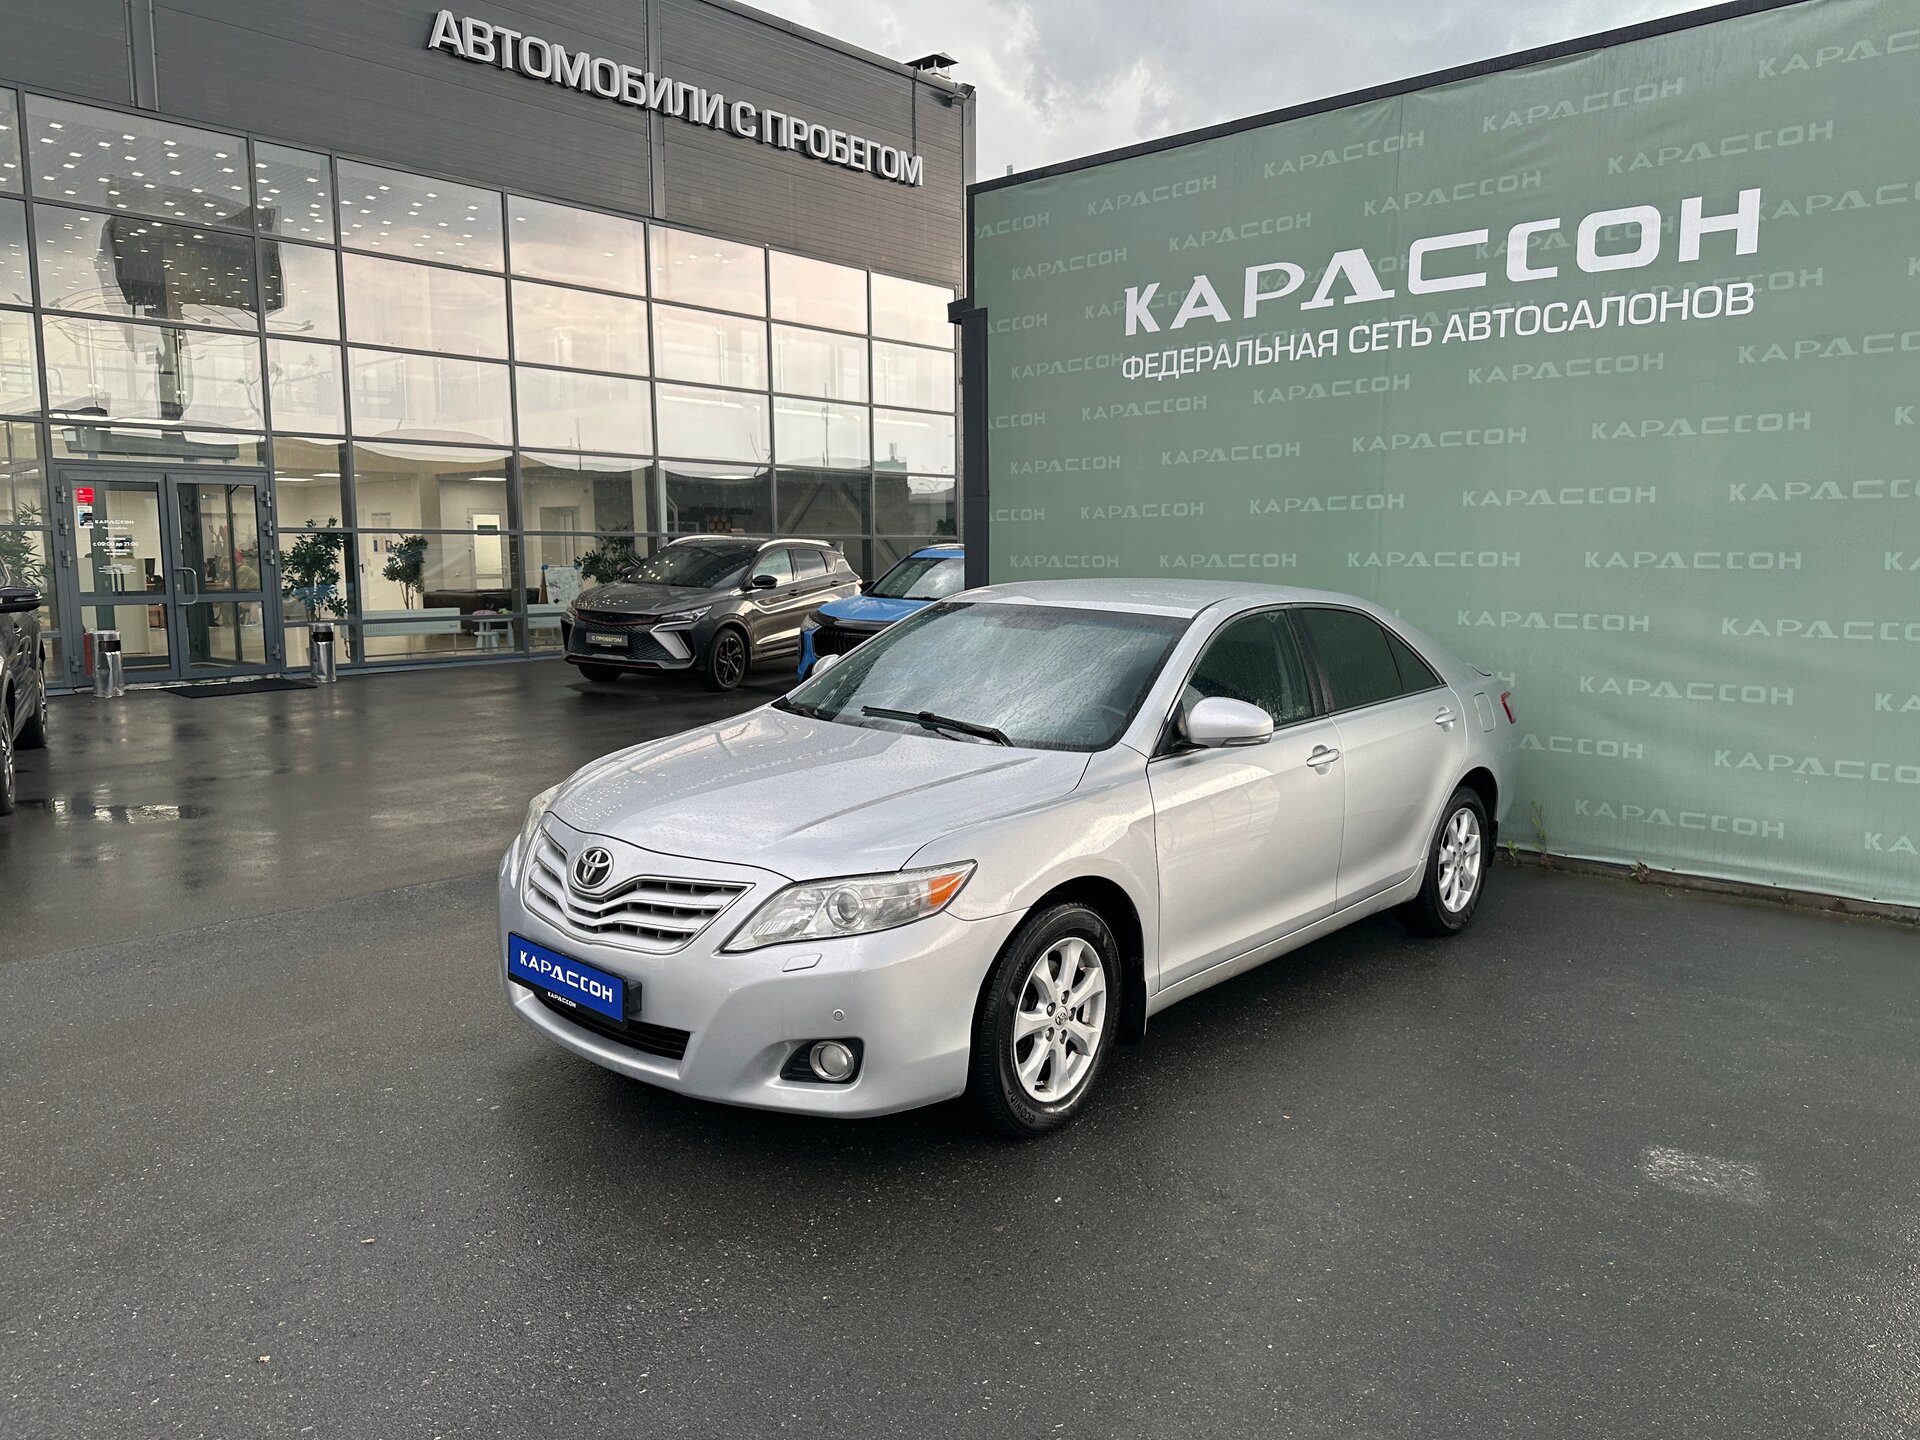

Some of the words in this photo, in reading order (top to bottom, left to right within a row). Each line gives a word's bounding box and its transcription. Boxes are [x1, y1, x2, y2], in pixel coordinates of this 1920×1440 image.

[428, 9, 726, 130] АВТОМОБИЛИ
[730, 101, 758, 138] С
[761, 109, 924, 187] ПРОБЕГОМ
[1124, 187, 1761, 337] КАРАССОН
[1121, 328, 1339, 382] ФЕДЕРАЛЬНАЯ
[1348, 318, 1433, 355] СЕТЬ
[1441, 281, 1755, 345] АВТОСАЛОНОВ
[520, 950, 613, 1003] КАРАССОН
